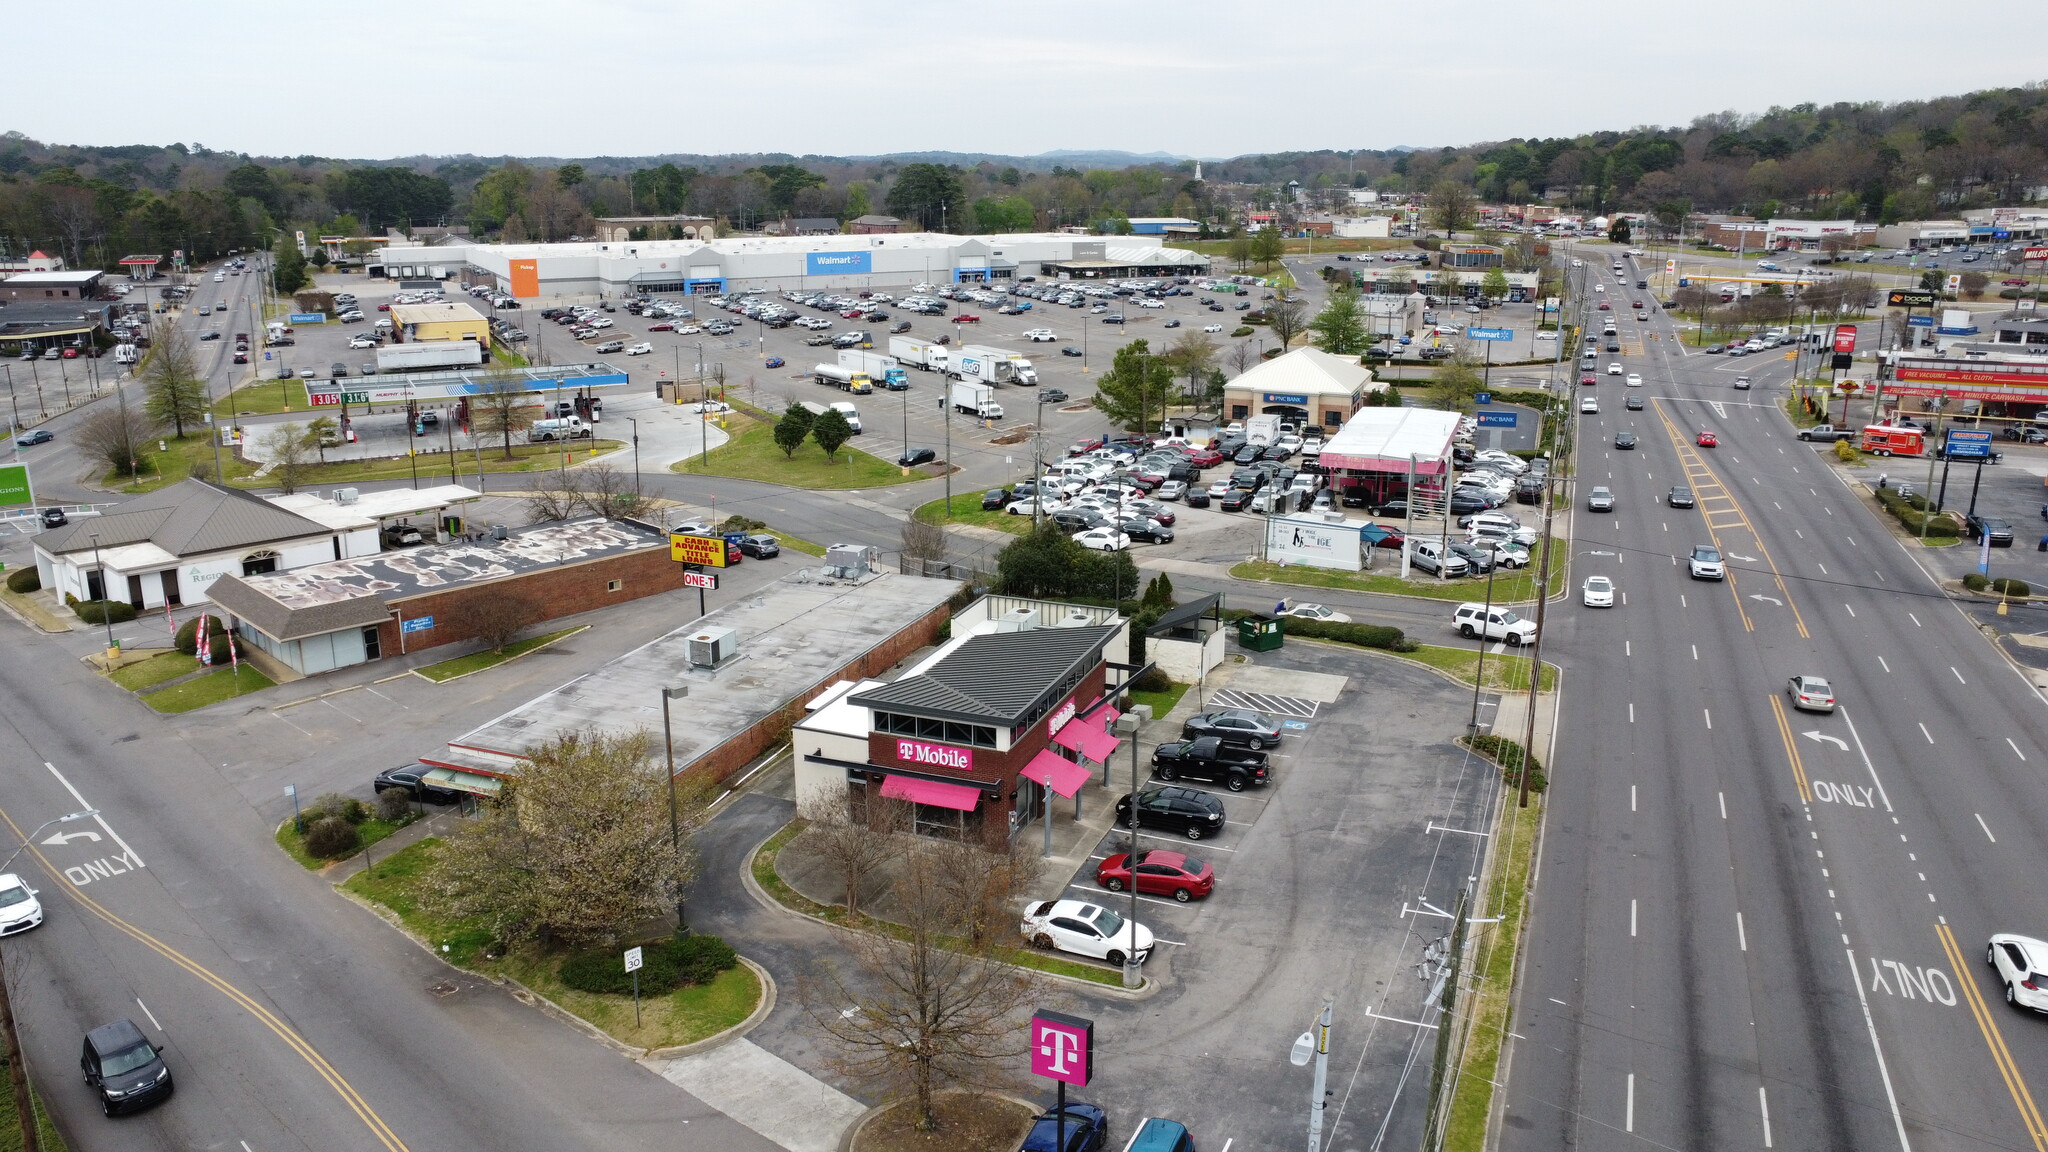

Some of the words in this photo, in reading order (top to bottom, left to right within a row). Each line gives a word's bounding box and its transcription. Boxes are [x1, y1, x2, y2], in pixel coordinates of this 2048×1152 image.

[817, 255, 851, 265] Walmart
[1471, 330, 1500, 339] Walmart
[1964, 392, 1990, 400] MINUTE
[1991, 393, 2026, 402] CARWASH
[684, 537, 710, 546] CASH
[675, 542, 720, 553] ADVANCE
[685, 550, 709, 558] TITLE
[682, 555, 714, 565] LOANS
[684, 574, 714, 587] ONE-T
[915, 745, 969, 769] Mobile
[1813, 781, 1875, 809] ONLY
[64, 852, 134, 886] ONLY
[627, 958, 640, 969] 30
[1870, 957, 1957, 1006] ONLY
[1041, 1026, 1078, 1075] T
